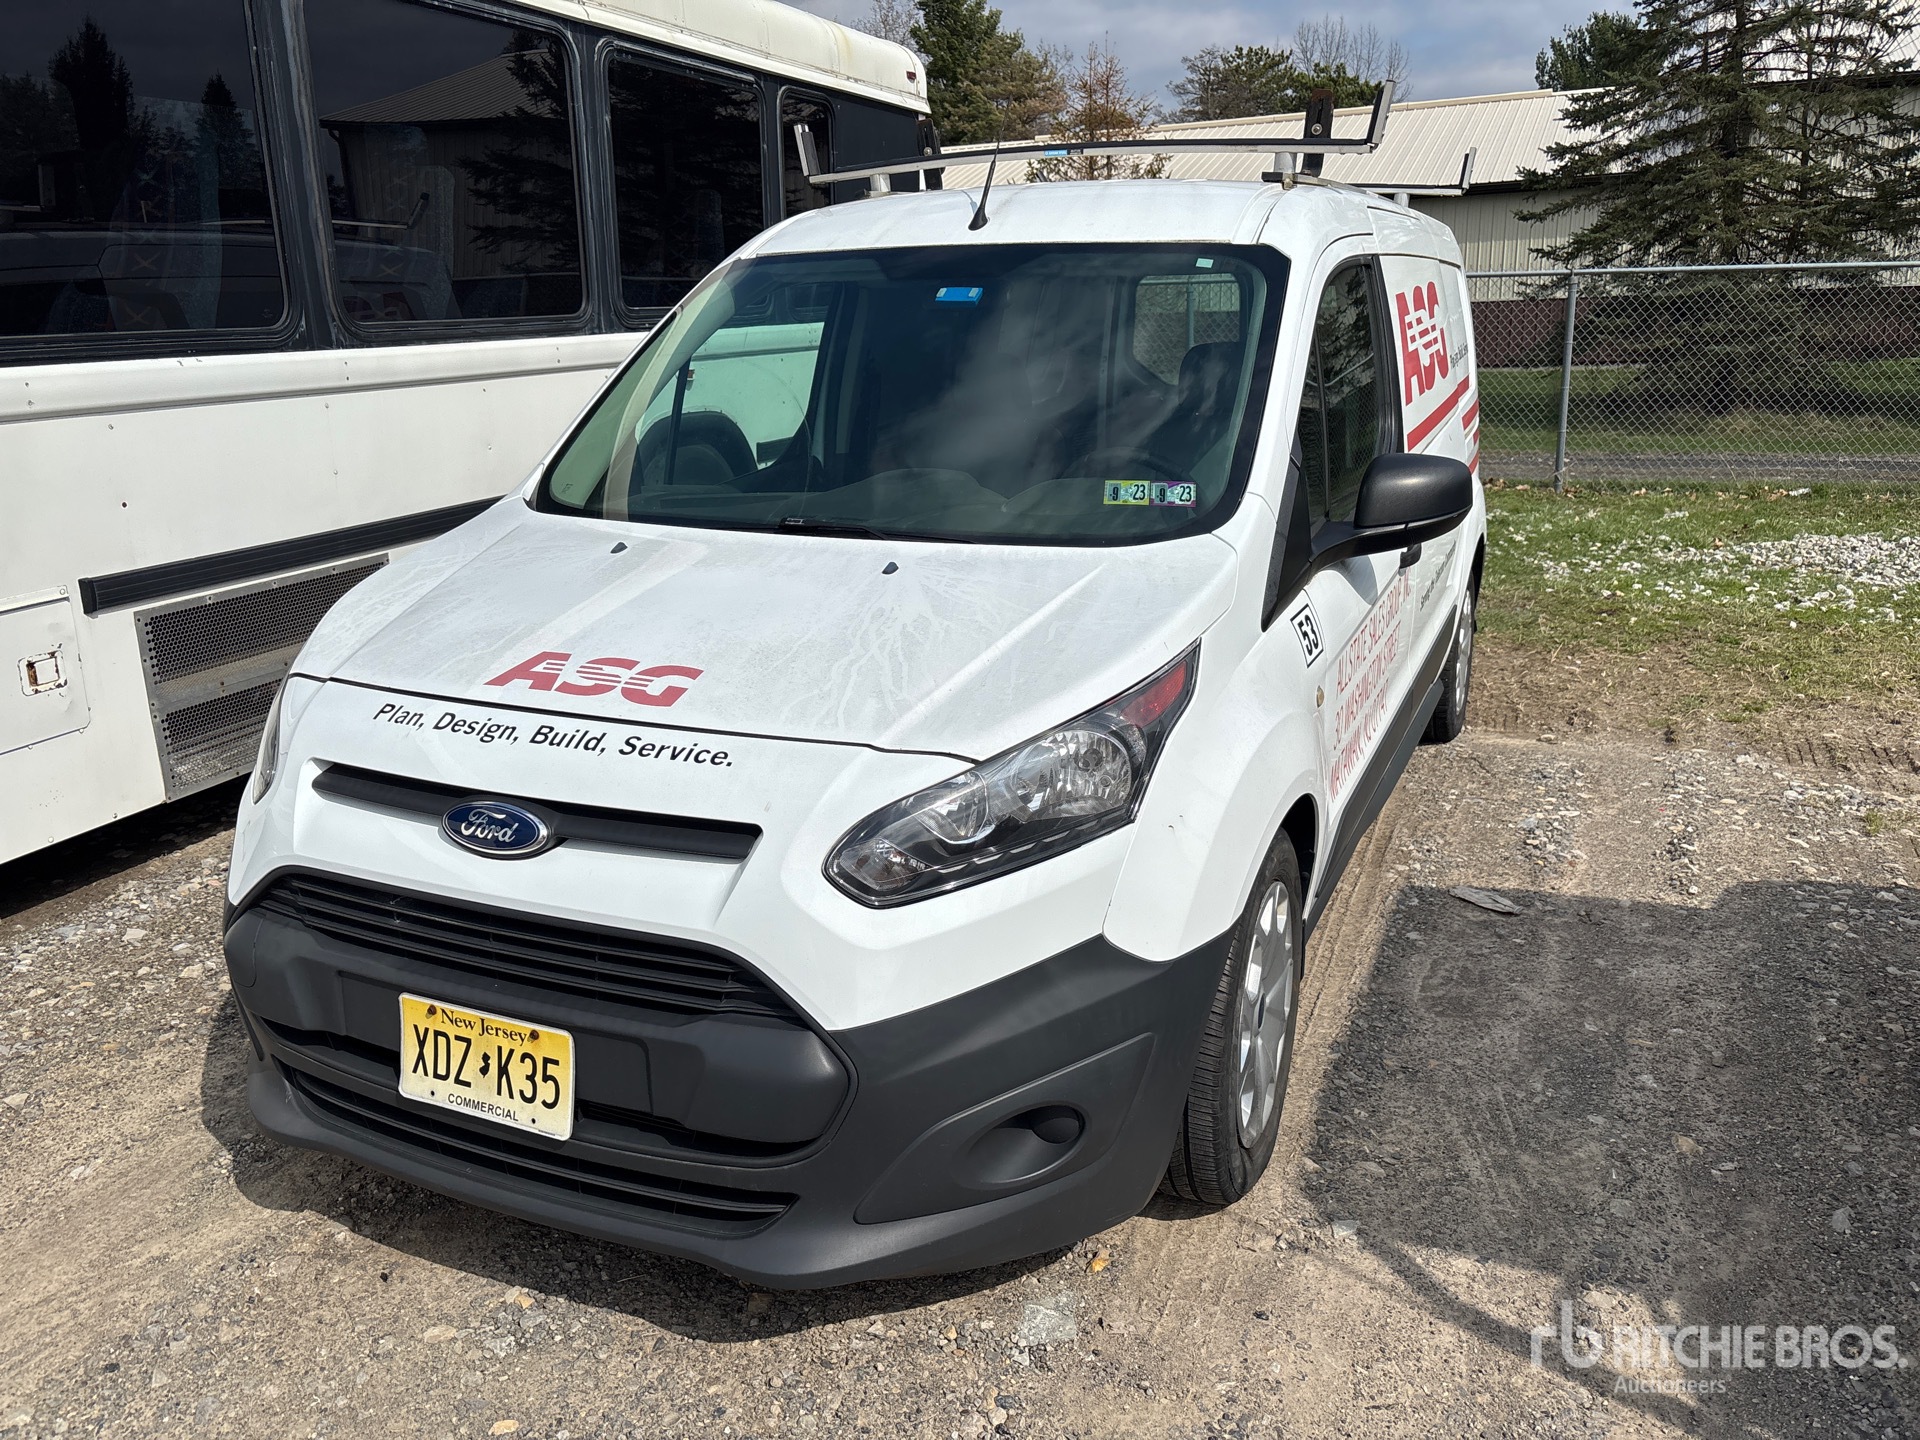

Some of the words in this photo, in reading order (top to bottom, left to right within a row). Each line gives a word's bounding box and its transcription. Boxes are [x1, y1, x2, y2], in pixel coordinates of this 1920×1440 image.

[1395, 281, 1449, 406] ASG
[1132, 484, 1146, 500] 23
[1180, 485, 1192, 502] 23
[1297, 614, 1320, 657] 53
[1336, 624, 1368, 701] ALLSTATE
[1368, 600, 1386, 655] SALES
[483, 651, 704, 708] ASG
[1333, 705, 1344, 751] 30
[1344, 648, 1382, 734] WASHINGTON
[1381, 619, 1401, 676] STREET
[372, 702, 425, 731] Plan,
[432, 712, 520, 745] Design,
[529, 724, 607, 756] Build,
[618, 735, 734, 767] Service.
[460, 808, 520, 845] Ford
[441, 1008, 476, 1030] New
[479, 1018, 528, 1046] Jersey
[412, 1024, 472, 1088] XDZ
[496, 1045, 561, 1110] K35
[448, 1093, 519, 1122] COMMERCIAL
